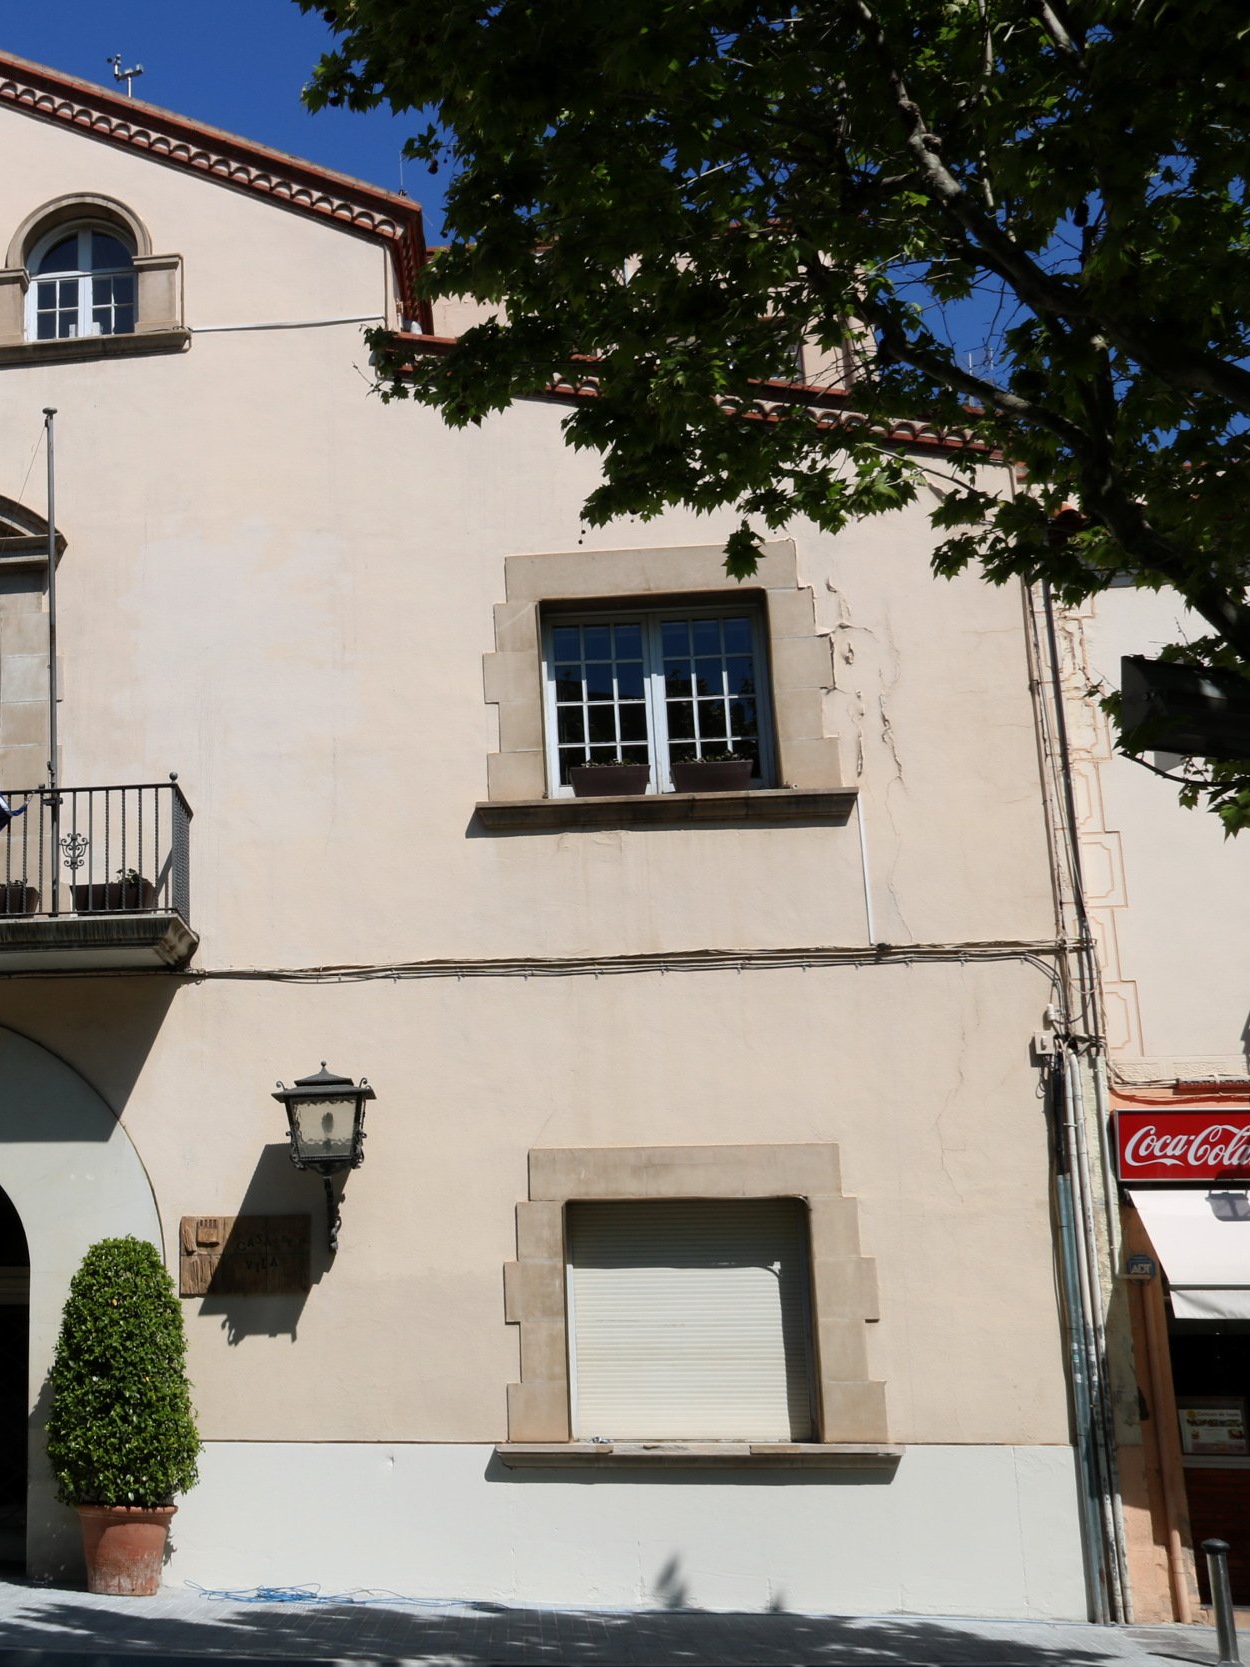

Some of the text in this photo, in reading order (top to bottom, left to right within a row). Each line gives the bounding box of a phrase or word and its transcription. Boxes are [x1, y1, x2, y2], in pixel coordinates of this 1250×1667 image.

[1125, 1125, 1250, 1166] Coca-Cola
[246, 1256, 278, 1273] VILA
[1131, 1263, 1152, 1274] ADT
